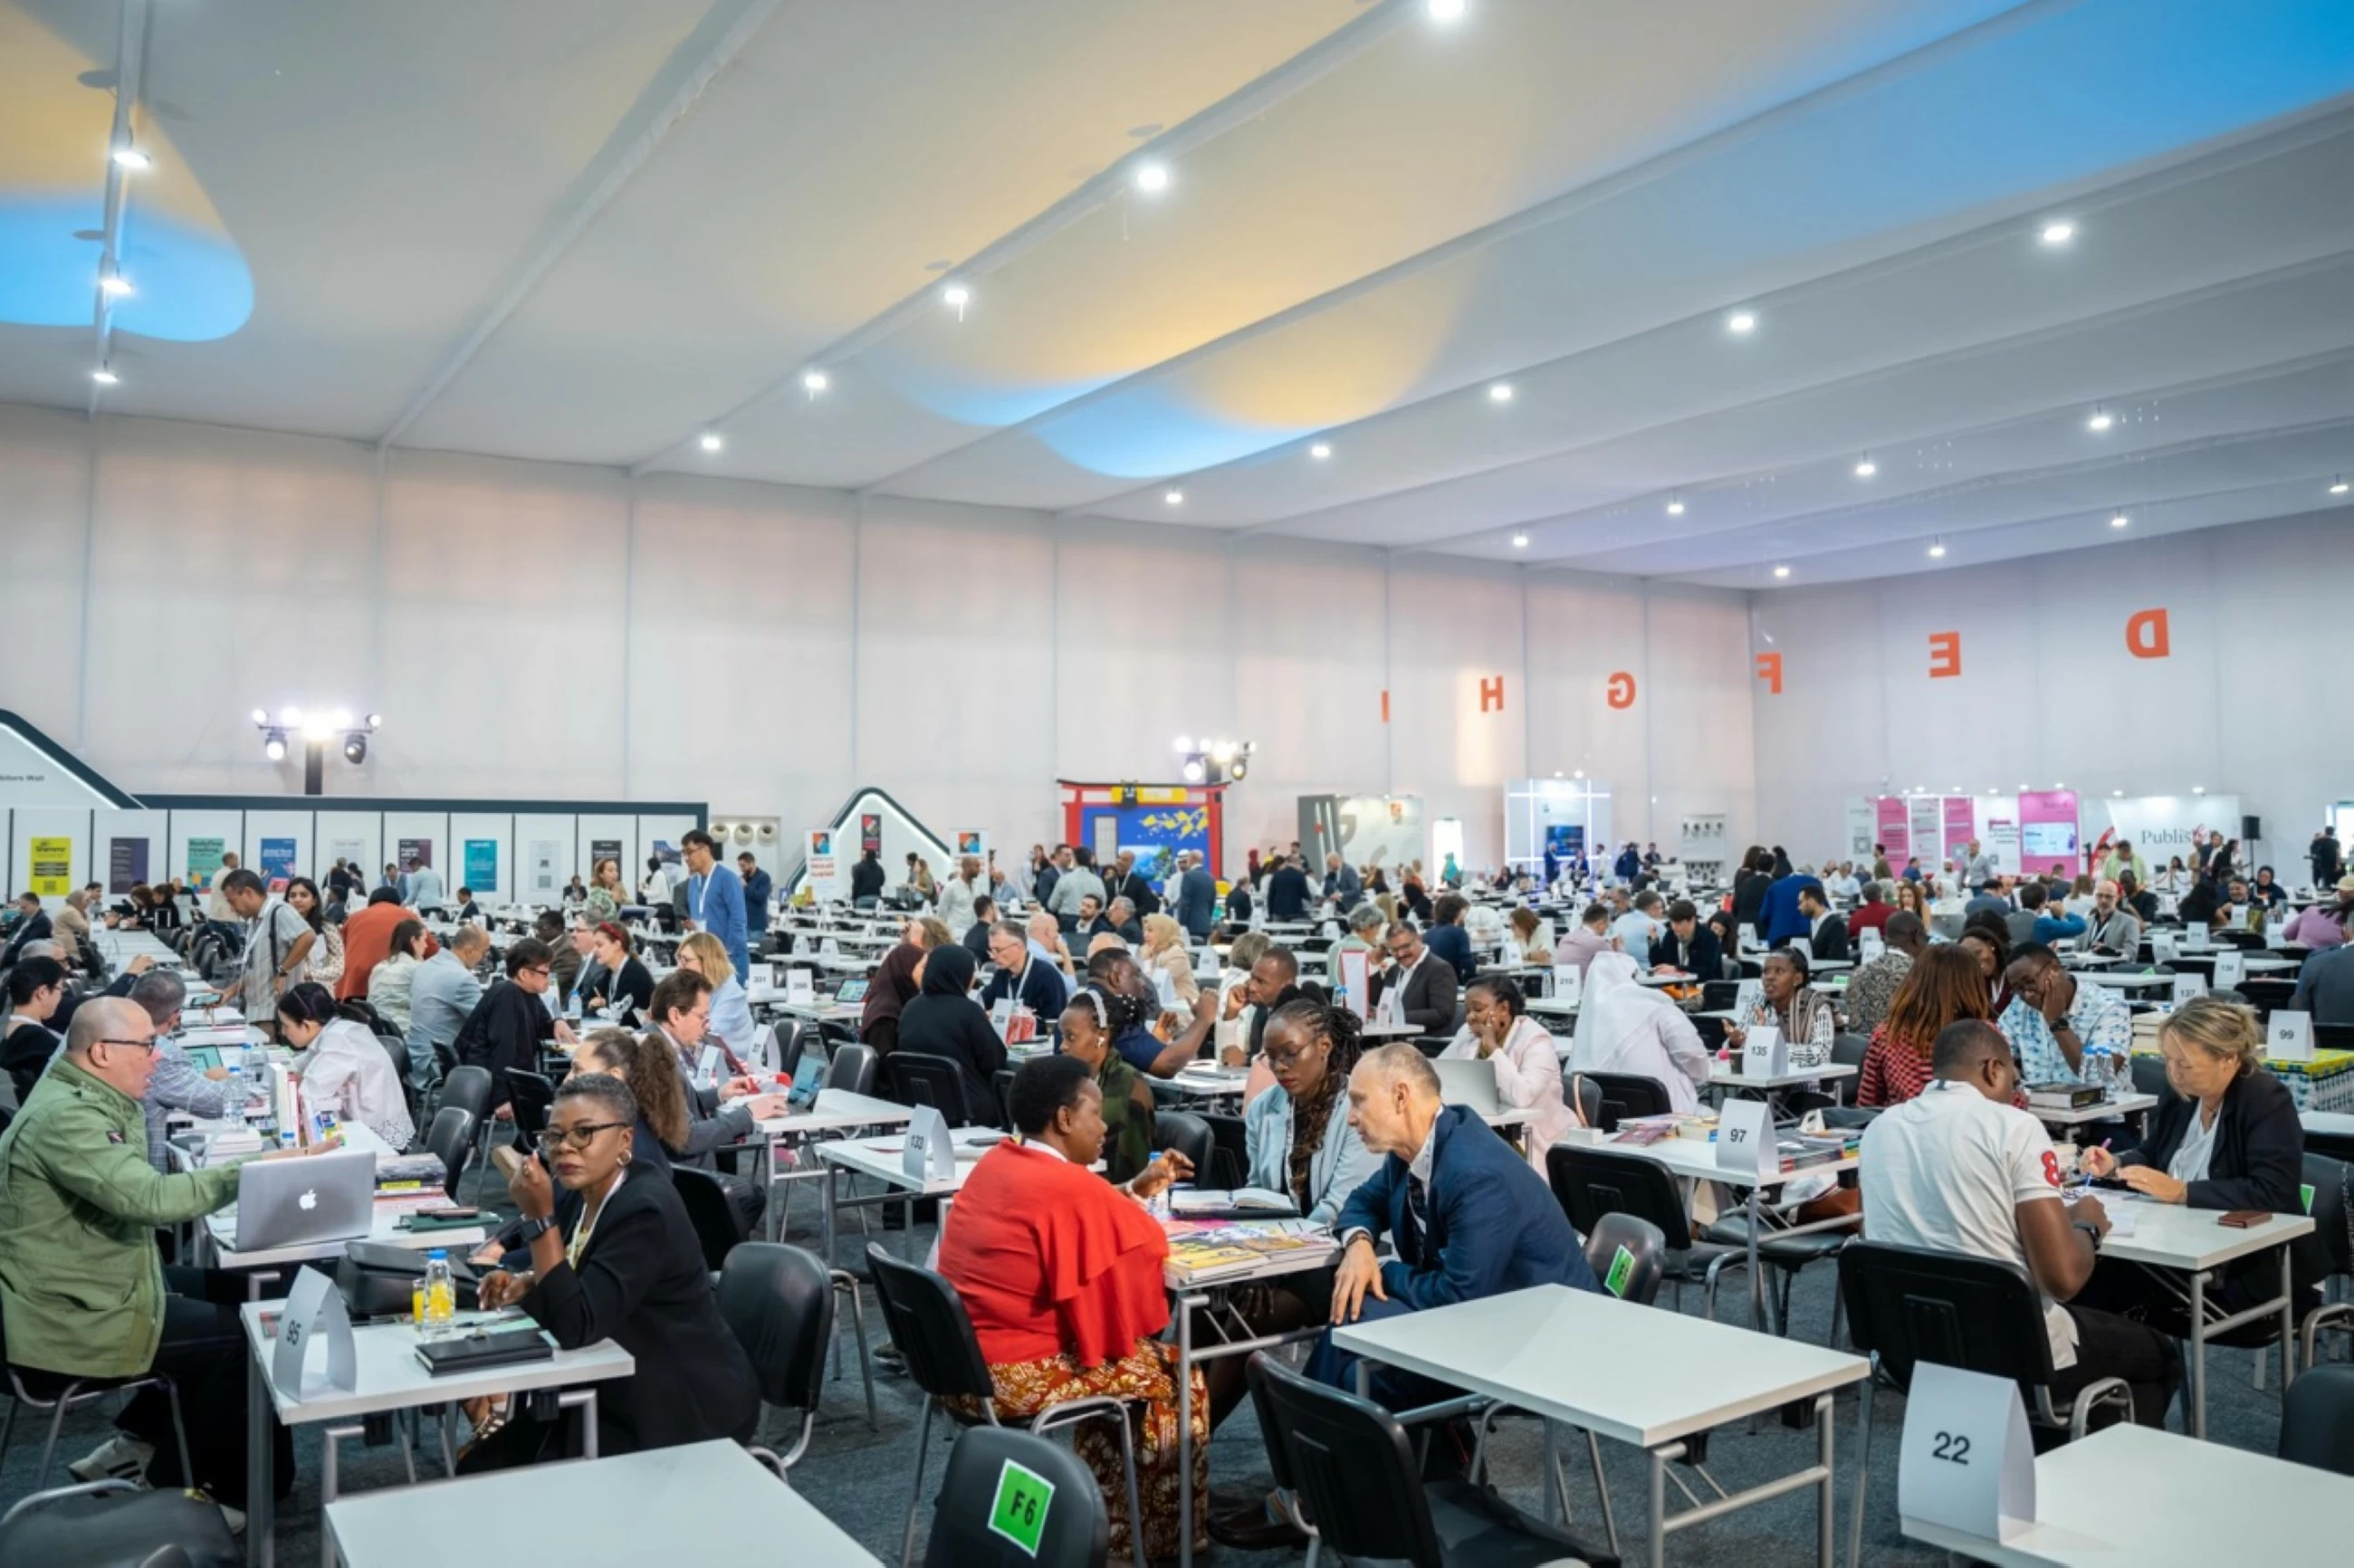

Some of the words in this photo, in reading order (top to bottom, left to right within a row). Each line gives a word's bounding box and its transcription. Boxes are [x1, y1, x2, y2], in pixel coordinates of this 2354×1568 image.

[2279, 1029, 2294, 1039] 99
[1730, 1128, 1747, 1143] 97
[286, 1319, 302, 1346] 95
[1932, 1430, 1971, 1466] 22
[1010, 1489, 1037, 1527] F6
